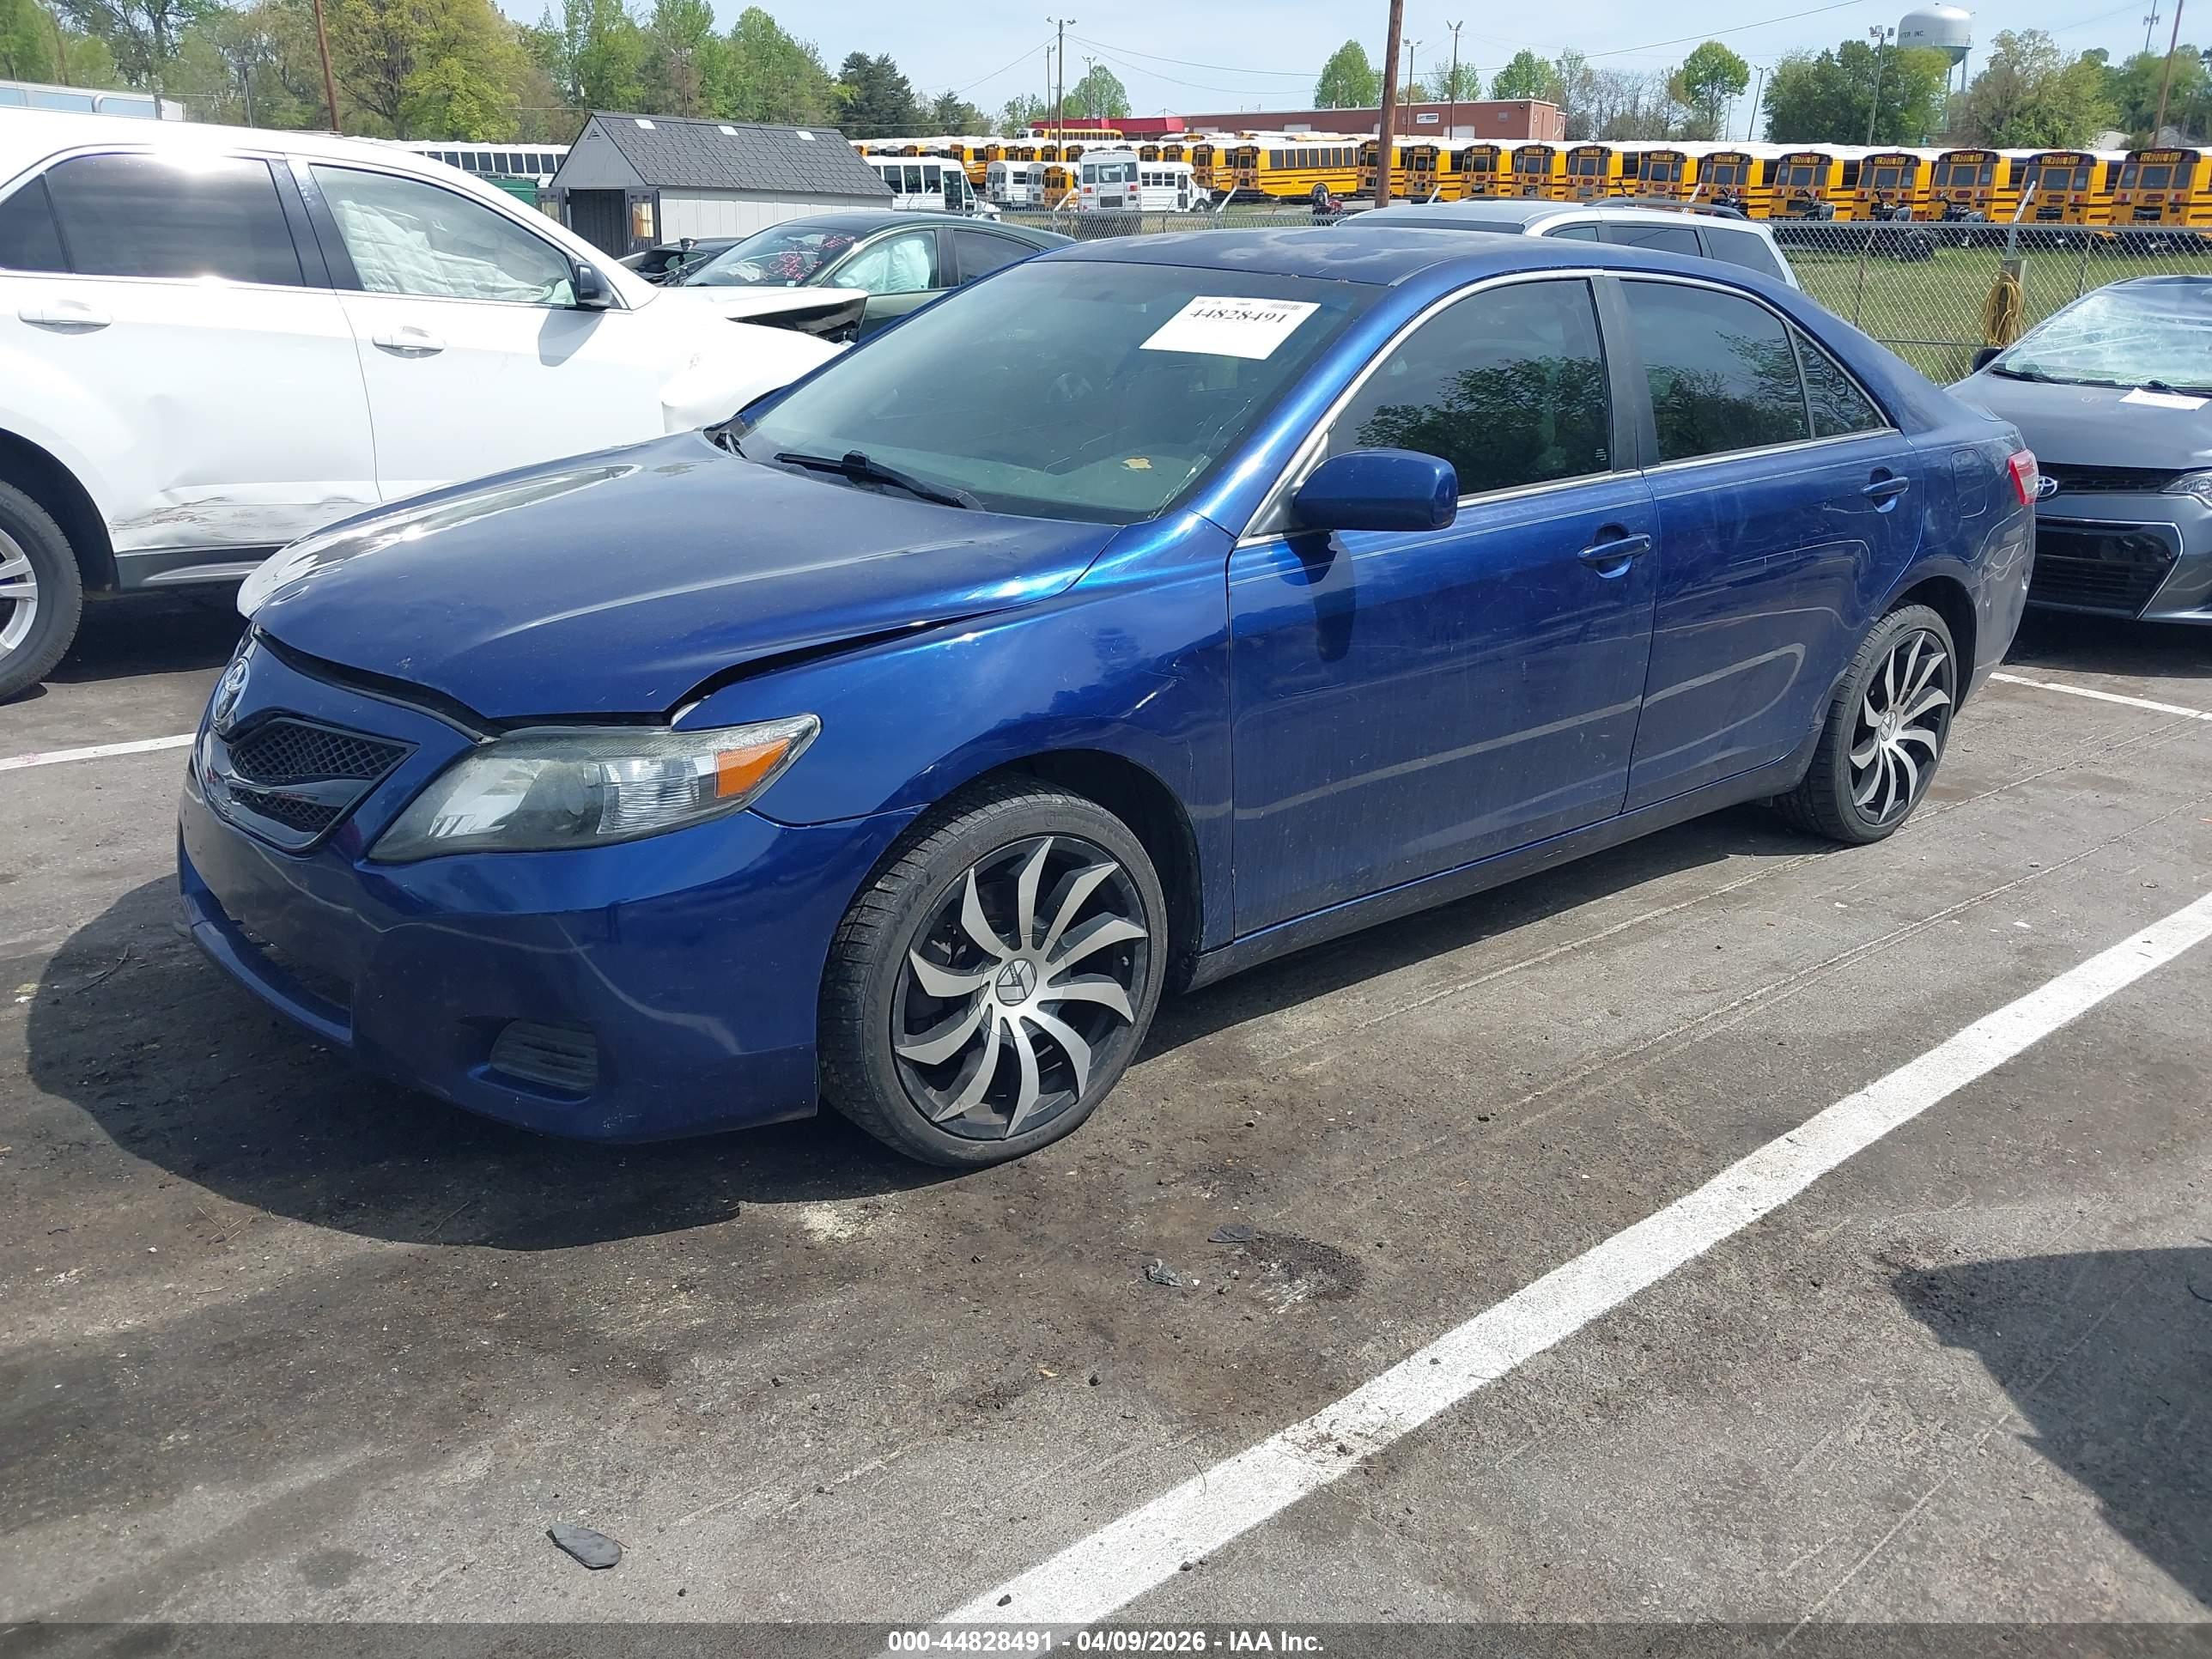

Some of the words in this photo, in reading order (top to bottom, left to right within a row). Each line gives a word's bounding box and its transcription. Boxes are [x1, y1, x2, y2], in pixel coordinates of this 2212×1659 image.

[1950, 153, 1970, 162] SCHOOL
[2043, 155, 2063, 165] SCHOOL
[2141, 152, 2164, 161] SCHOOL
[2170, 152, 2181, 161] BUS
[1190, 308, 1288, 323] 44828491
